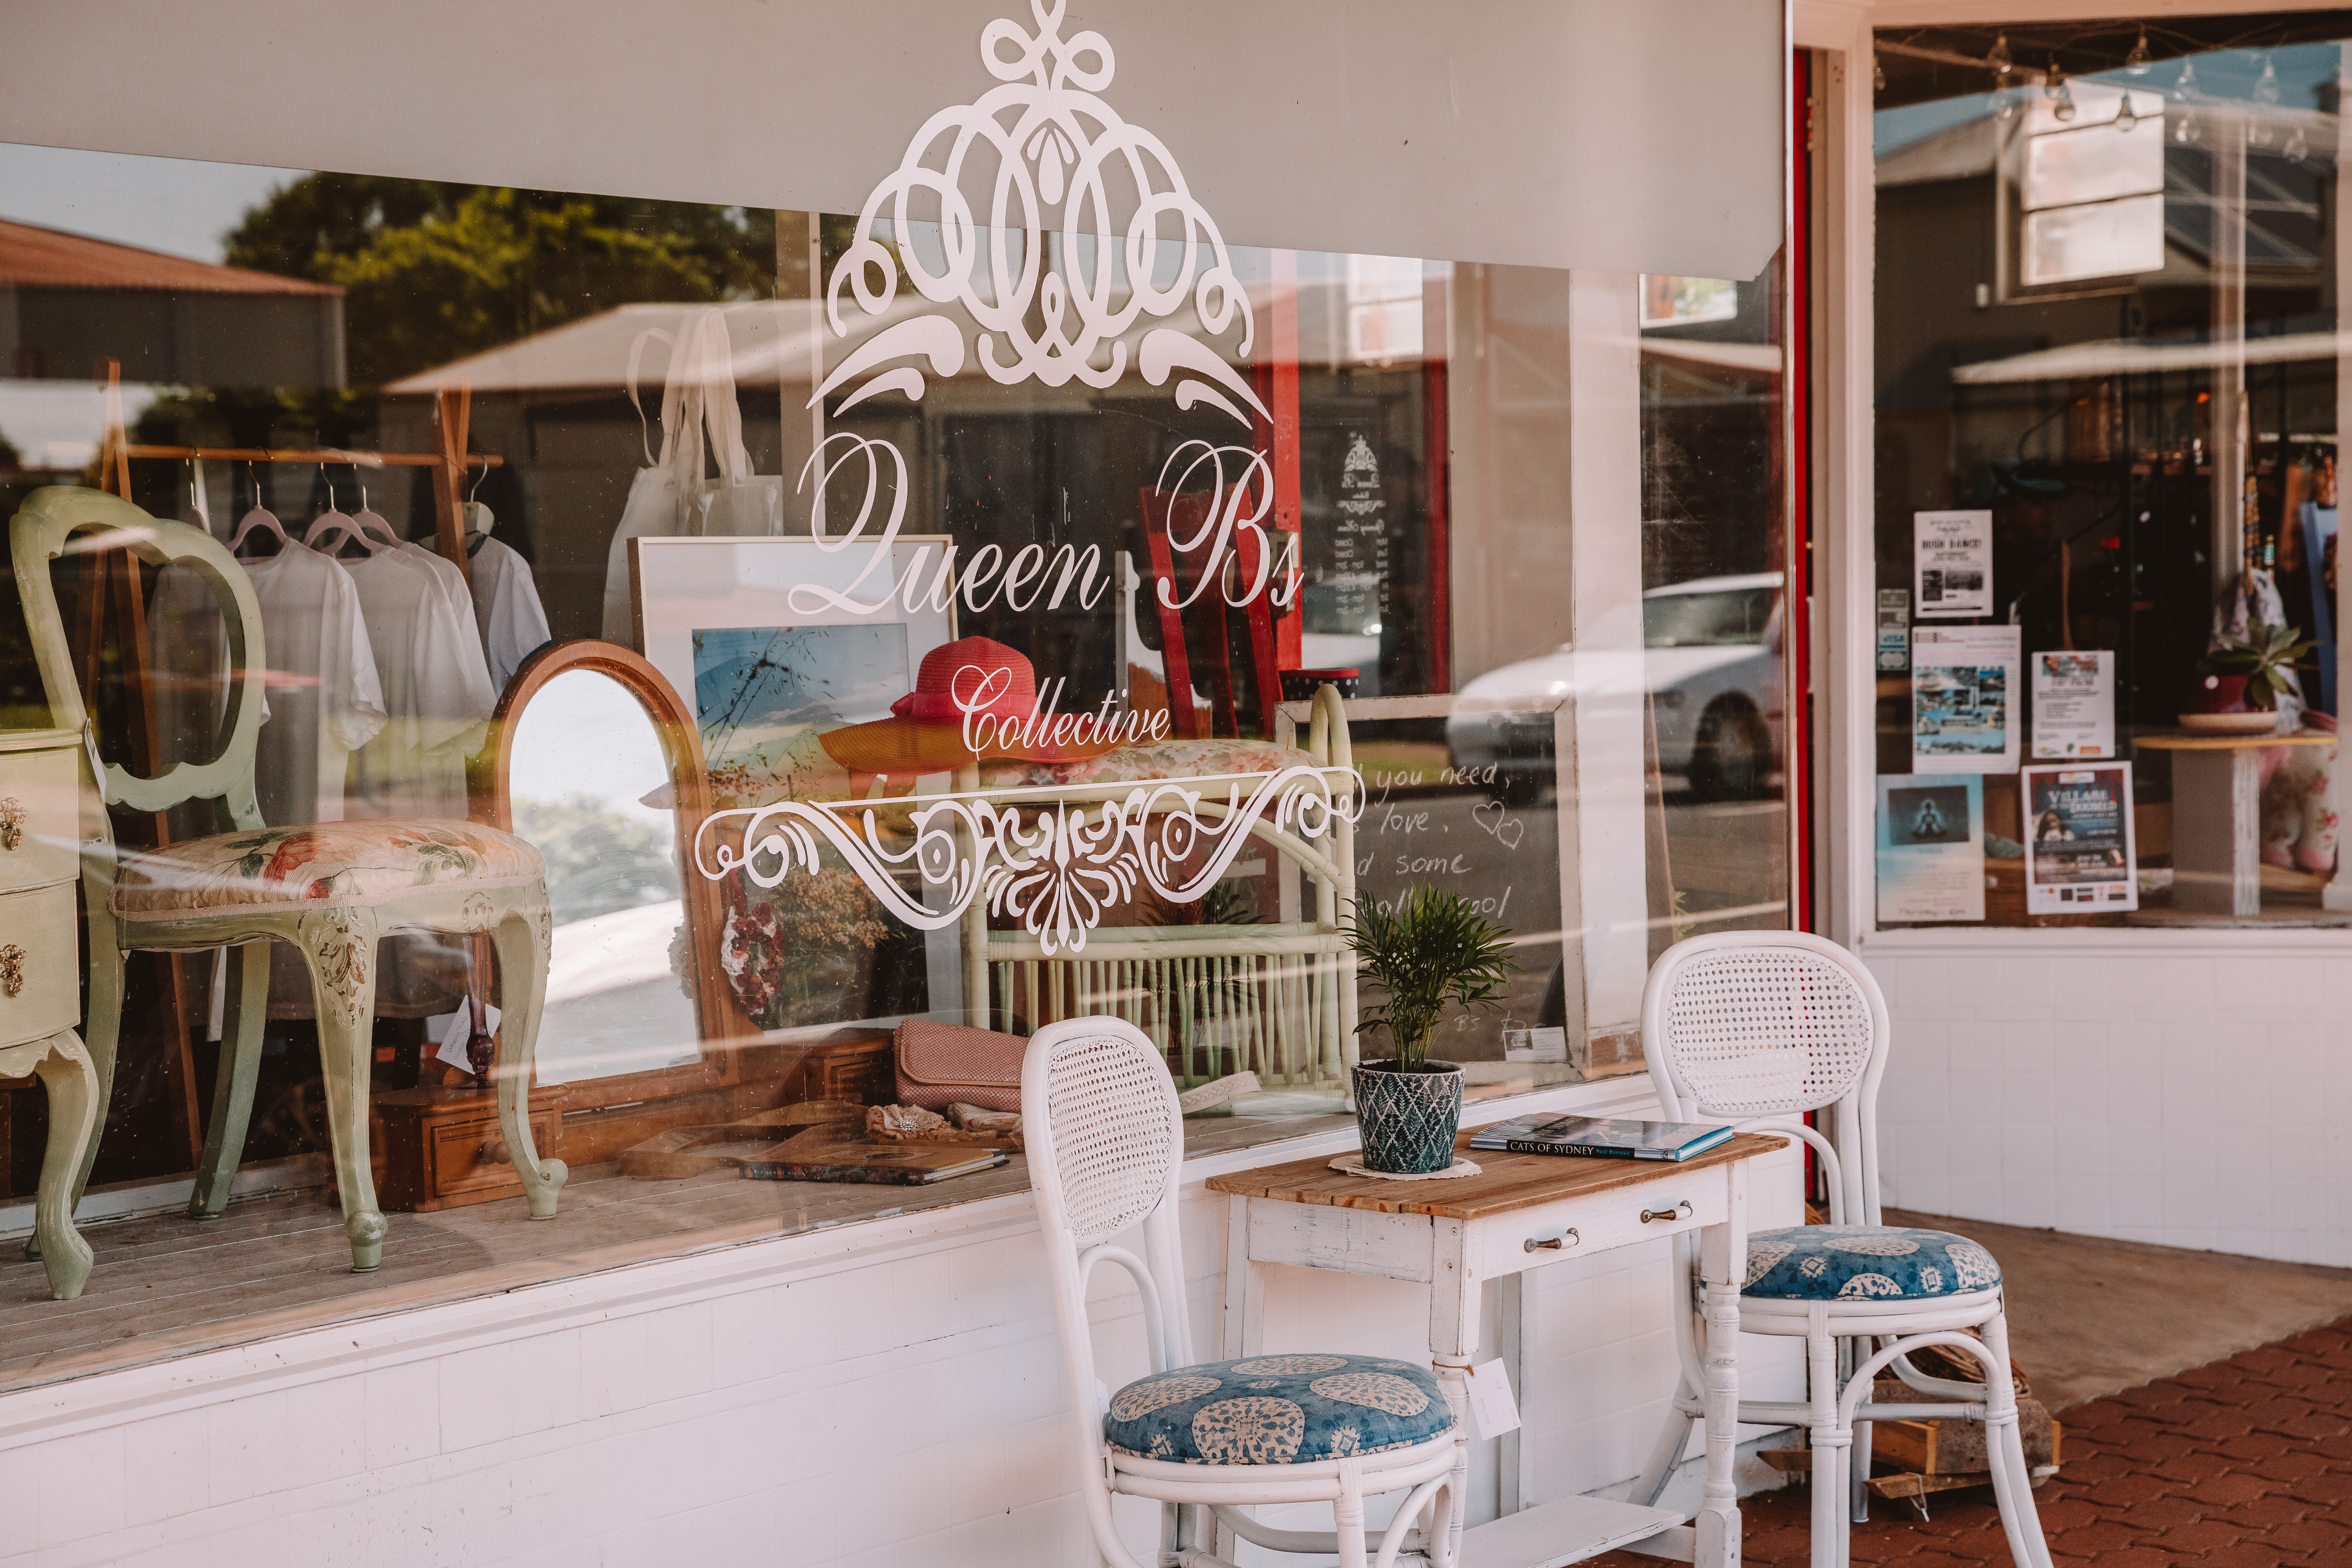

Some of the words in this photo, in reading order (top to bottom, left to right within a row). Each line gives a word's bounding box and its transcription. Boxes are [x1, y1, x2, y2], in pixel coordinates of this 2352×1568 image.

[788, 432, 1110, 615] Queen
[951, 665, 1170, 761] Collective
[1374, 771, 1423, 808] you
[1396, 853, 1472, 875] some
[1510, 1142, 1534, 1151] CATS
[1538, 1144, 1551, 1152] OF
[1554, 1144, 1594, 1155] SYDNEY
